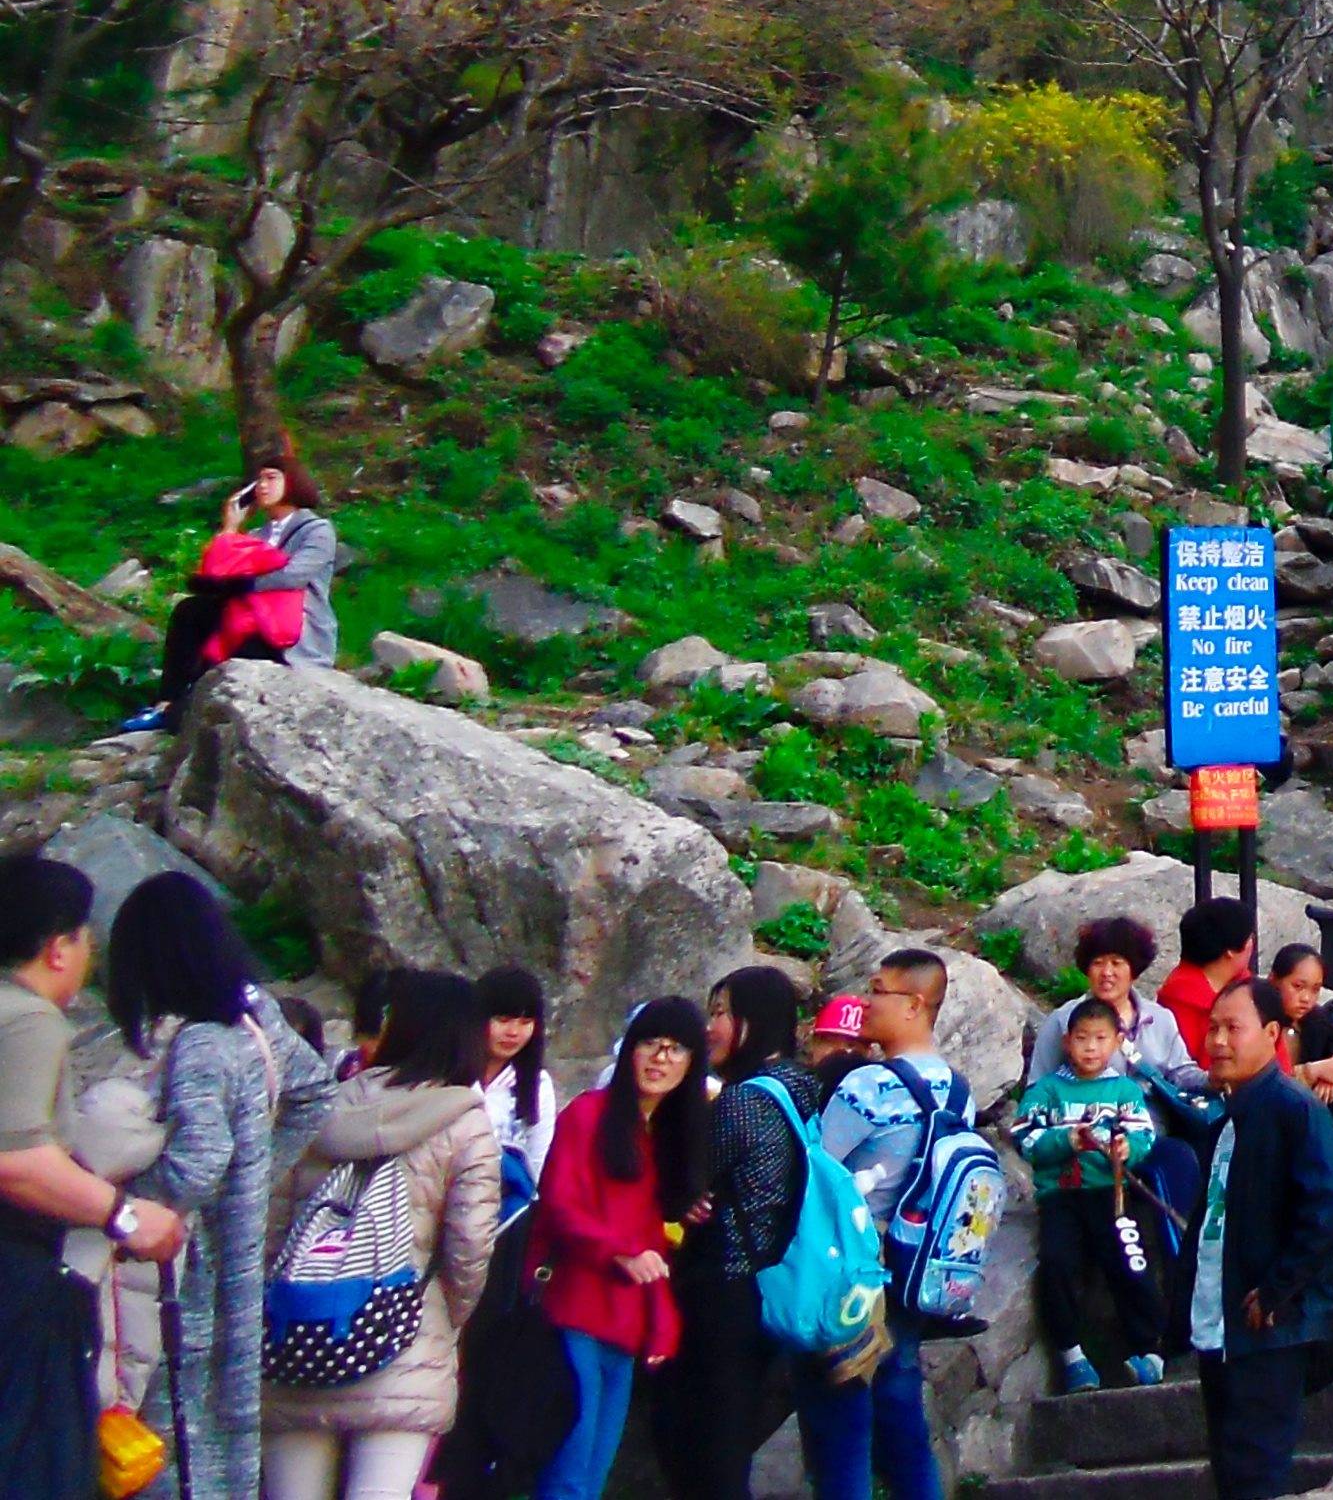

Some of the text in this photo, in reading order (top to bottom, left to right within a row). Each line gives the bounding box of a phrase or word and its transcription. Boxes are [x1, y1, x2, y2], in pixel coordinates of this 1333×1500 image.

[1177, 540, 1265, 567] 保持整洁
[1176, 573, 1269, 595] Keep clean
[1178, 604, 1268, 631] 禁止烟火
[1191, 636, 1253, 655] No fire
[1180, 664, 1269, 692] 注意安全
[1182, 696, 1269, 718] Be careful
